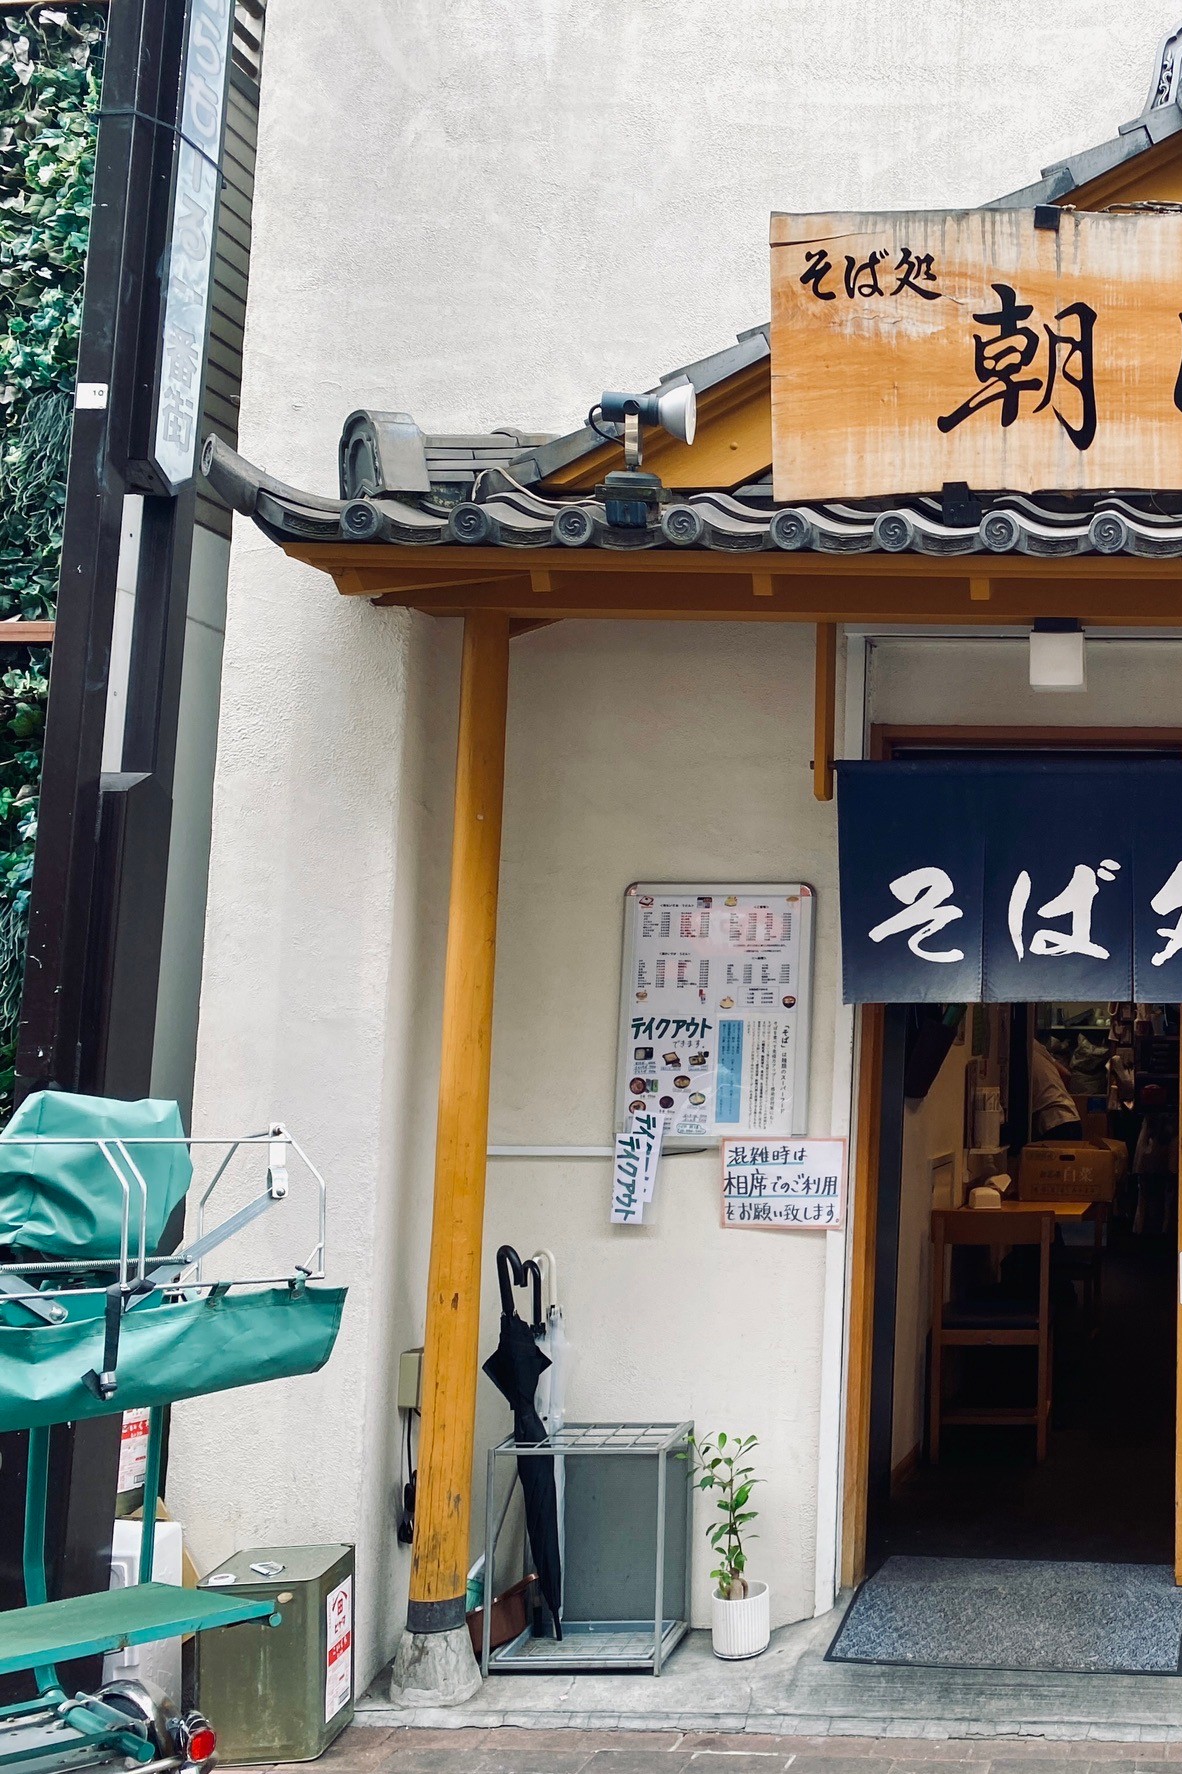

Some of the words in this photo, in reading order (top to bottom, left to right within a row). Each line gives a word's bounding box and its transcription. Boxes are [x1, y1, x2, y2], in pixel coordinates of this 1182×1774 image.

[797, 246, 944, 301] そば処
[631, 1016, 713, 1040] テイクアウト
[728, 1146, 808, 1164] 混雑時は
[614, 1136, 641, 1221] テイクアウト
[723, 1169, 838, 1197] 相席でのご利用
[726, 1202, 840, 1224] をお願い致します。
